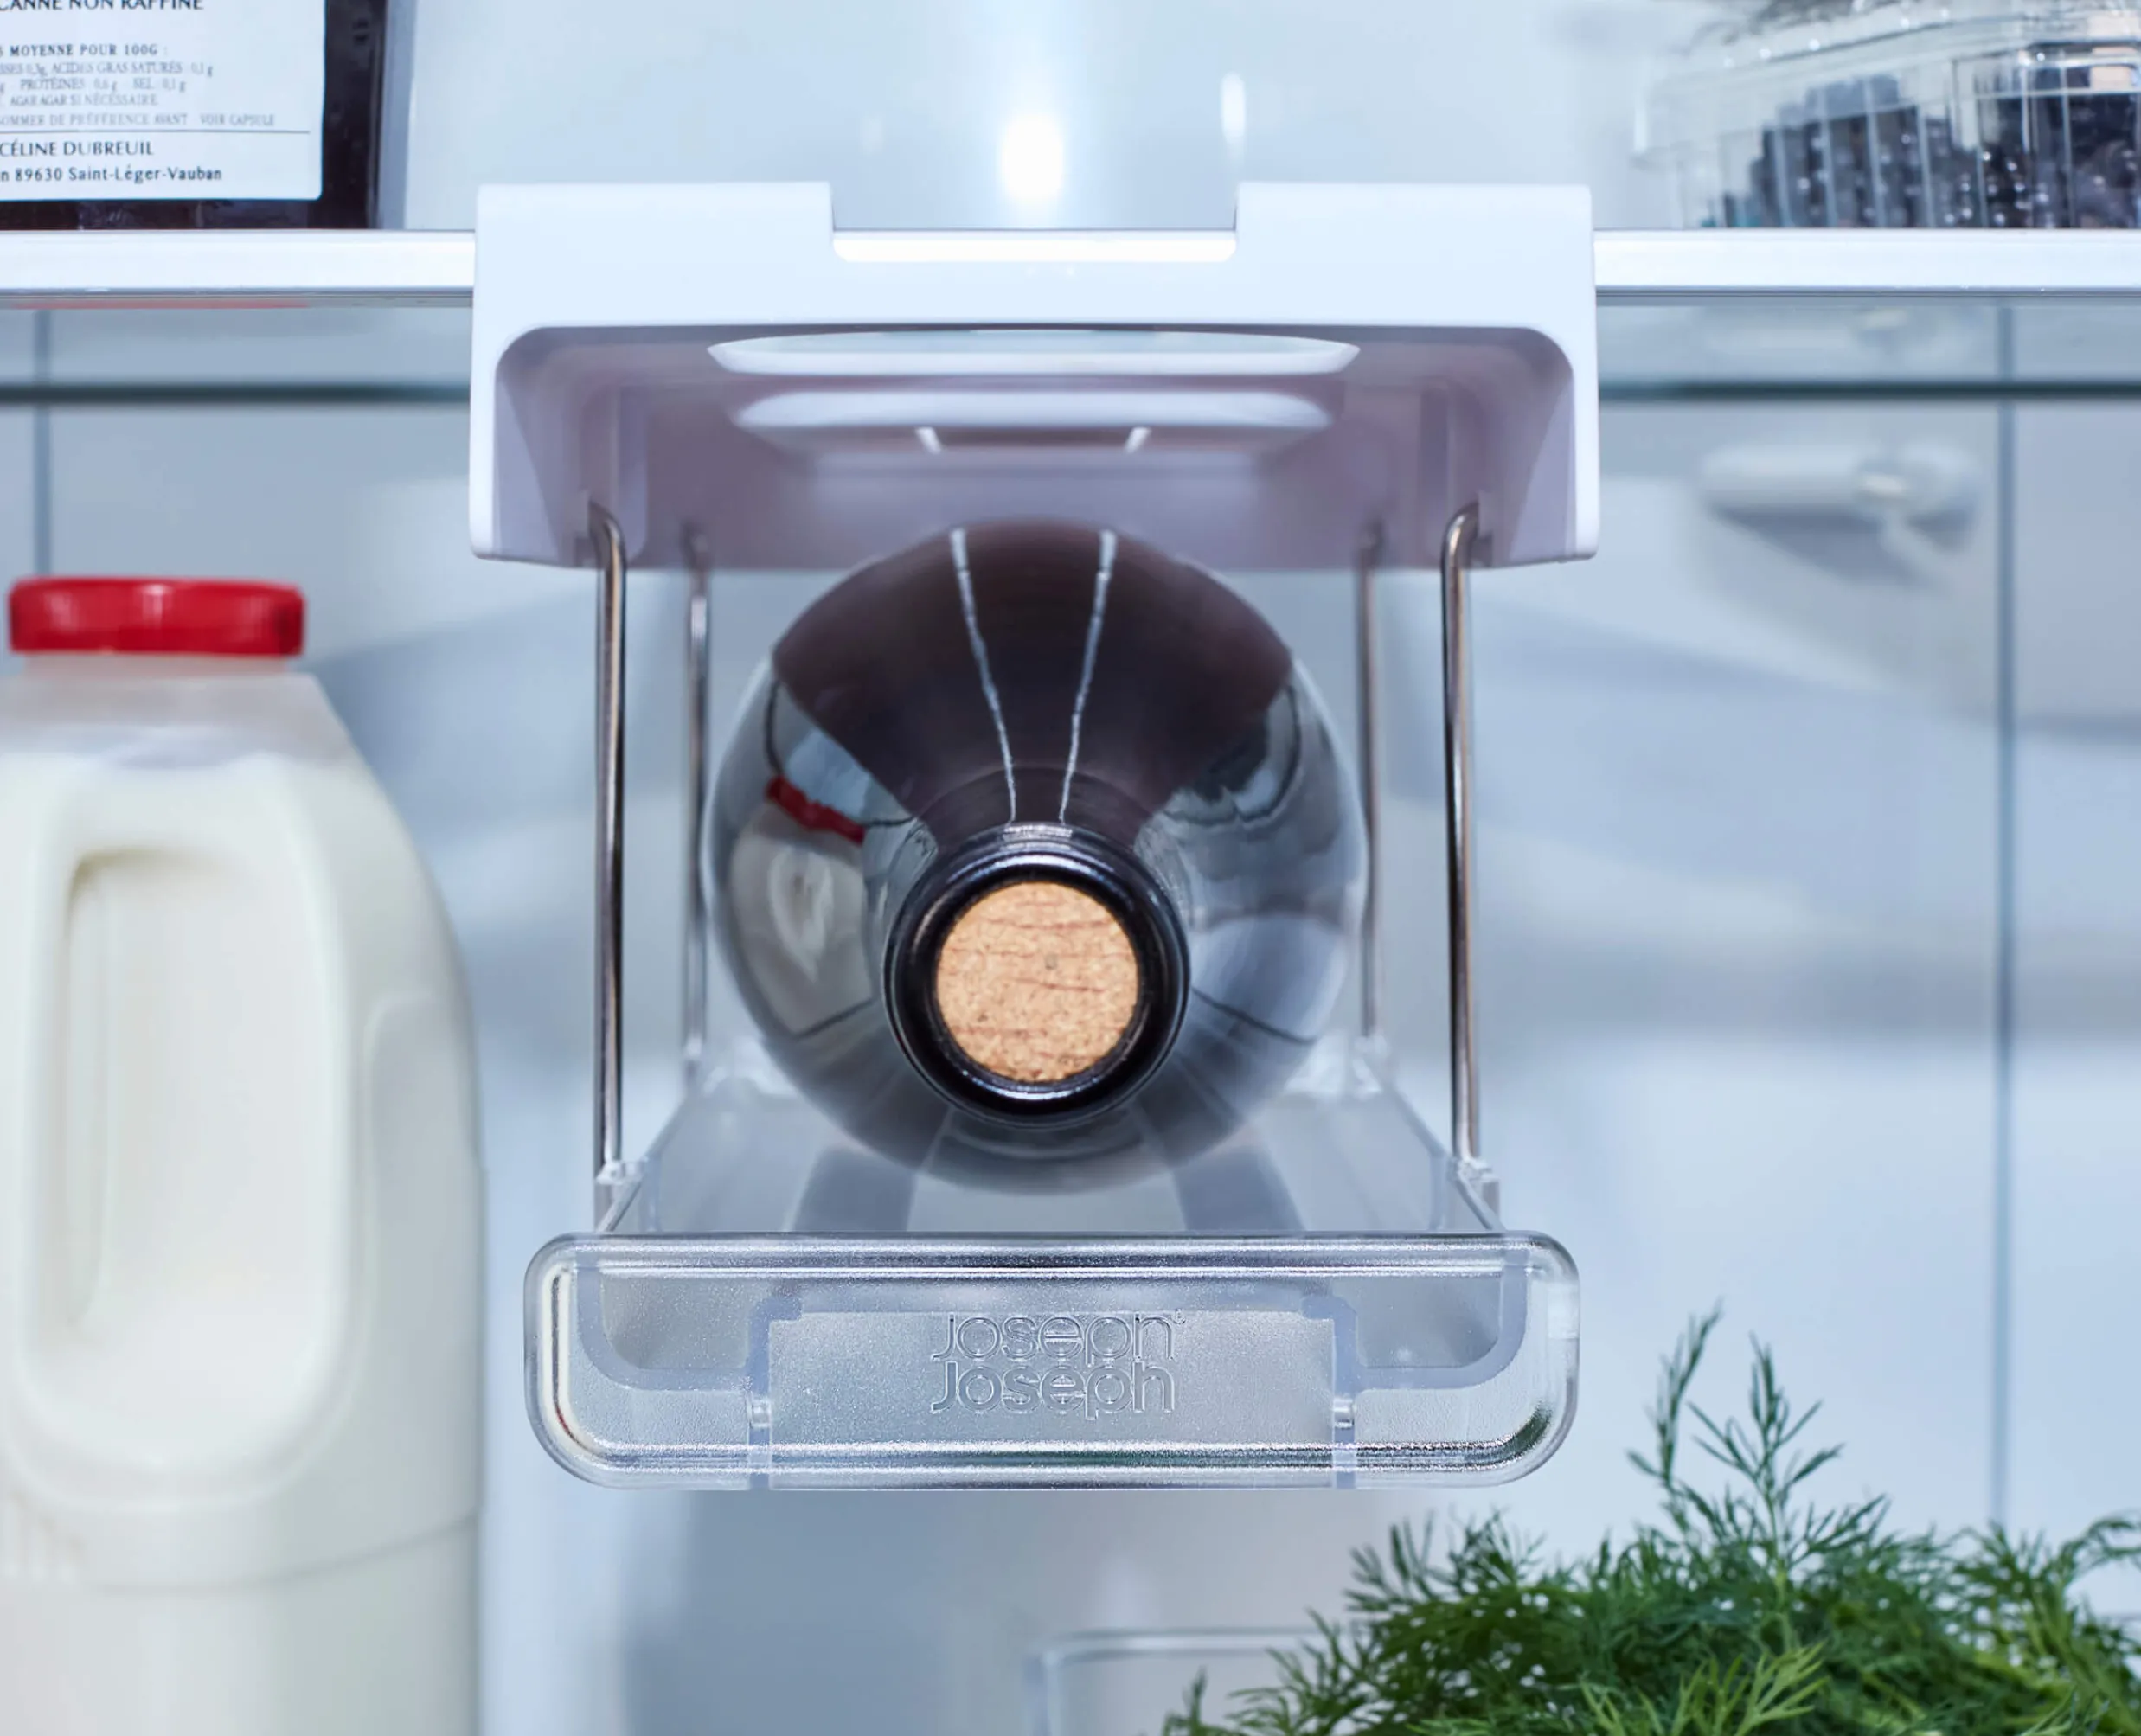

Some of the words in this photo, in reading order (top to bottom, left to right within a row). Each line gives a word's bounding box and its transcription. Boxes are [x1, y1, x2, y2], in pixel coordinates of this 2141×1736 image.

[69, 0, 113, 10] NON
[10, 44, 74, 56] MOYENNE
[80, 44, 117, 55] POUR
[125, 44, 157, 55] 100G
[50, 114, 66, 125] DE
[154, 113, 188, 125] AVANT
[200, 113, 225, 126] VOIR
[0, 138, 56, 157] CÉLINE
[63, 141, 154, 157] DUBREUIL
[16, 167, 62, 182] 89630
[68, 164, 222, 184] Saint-Léger-Vauban
[930, 1361, 1175, 1420] Joseph
